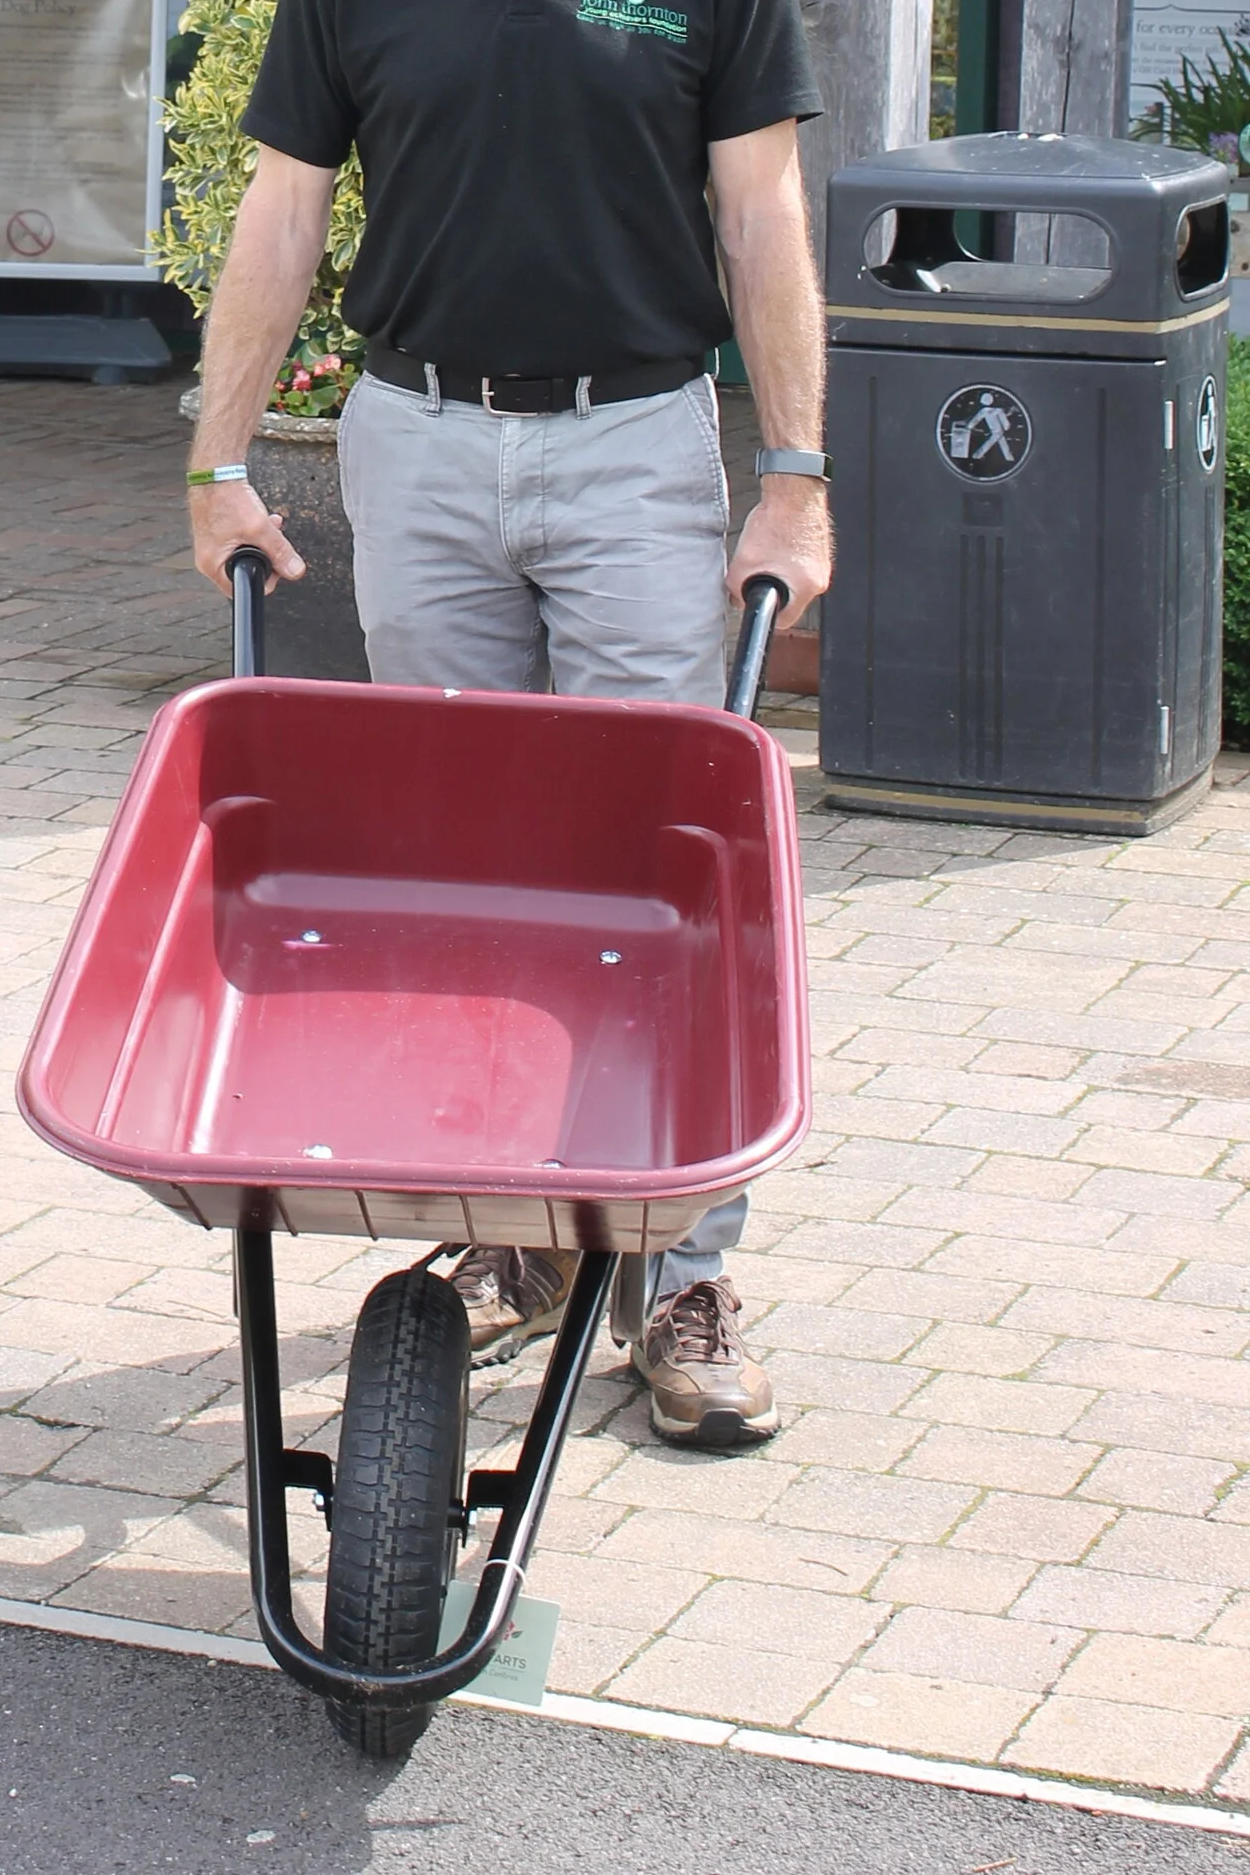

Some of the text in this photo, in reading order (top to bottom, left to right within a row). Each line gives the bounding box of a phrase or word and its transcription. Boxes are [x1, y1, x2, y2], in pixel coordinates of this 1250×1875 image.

[1136, 20, 1155, 35] for
[1158, 24, 1196, 38] every
[494, 1654, 527, 1669] ARTS
